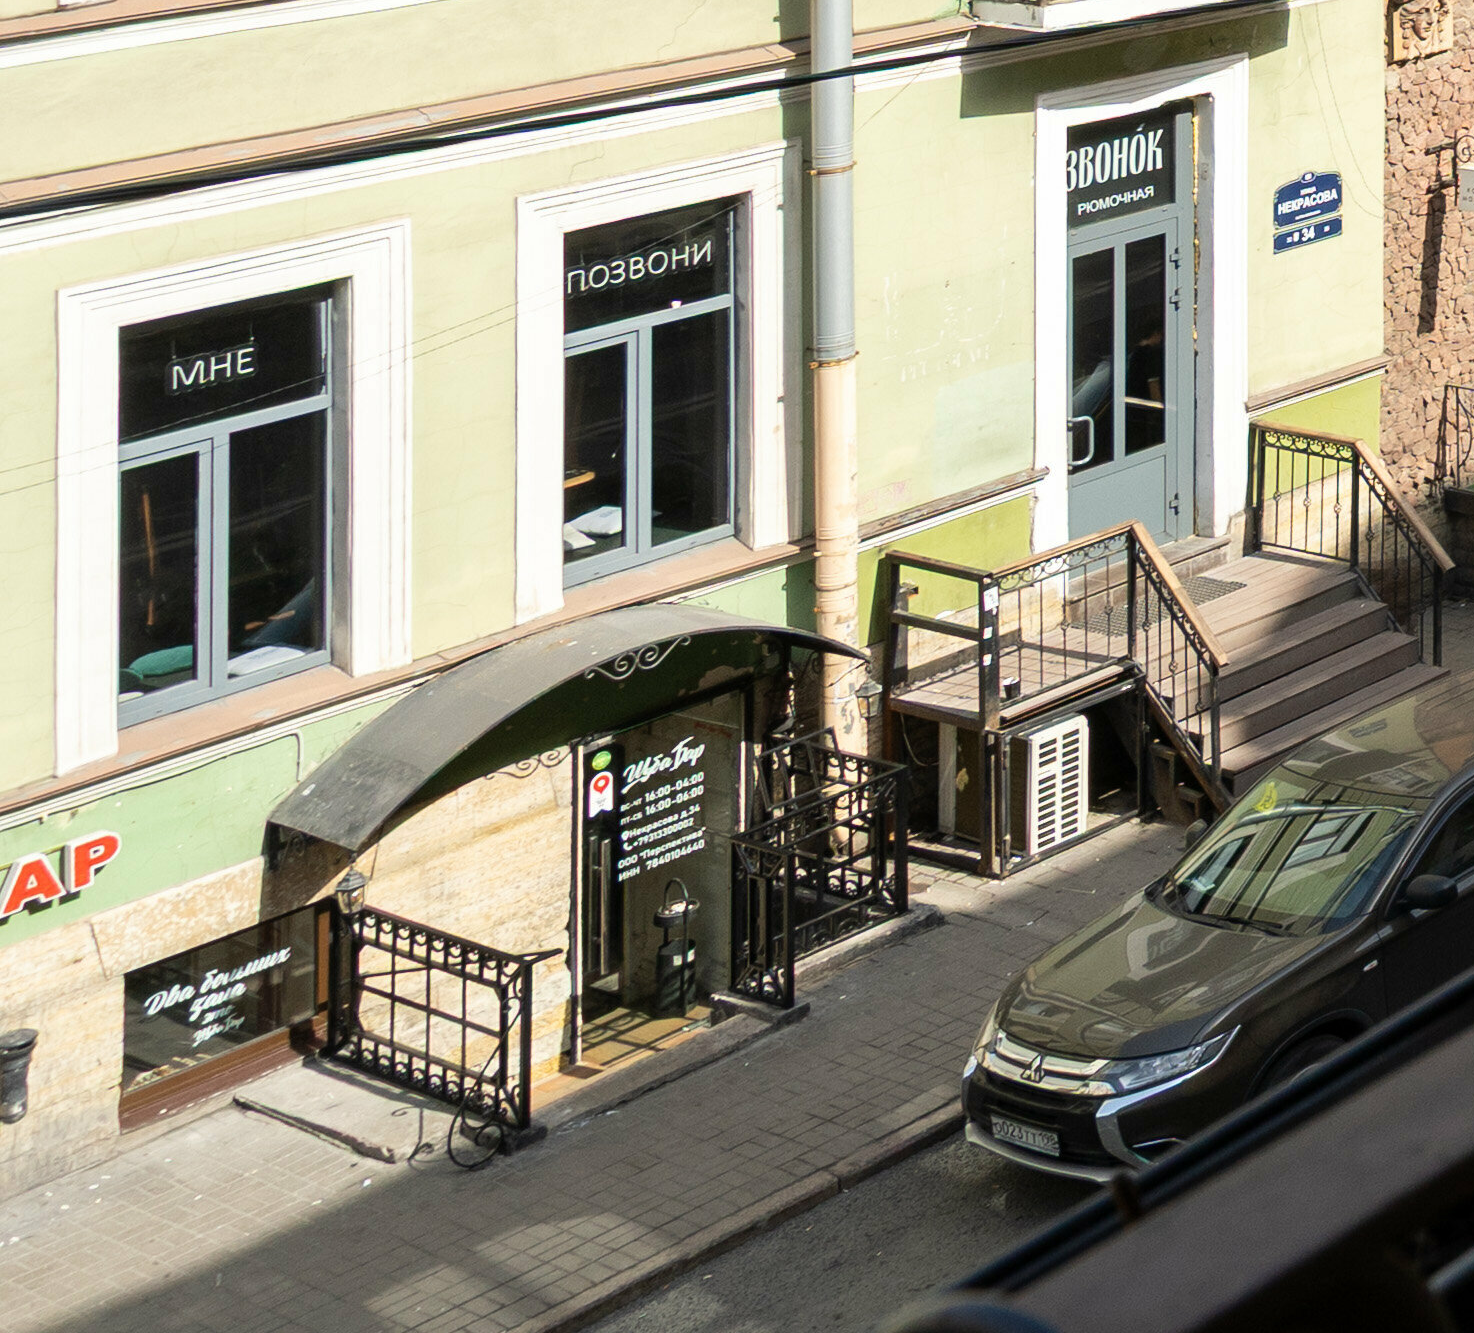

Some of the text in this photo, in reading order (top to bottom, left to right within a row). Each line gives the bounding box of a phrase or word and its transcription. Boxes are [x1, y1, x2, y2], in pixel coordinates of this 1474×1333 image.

[1078, 185, 1155, 215] РЮМОЧНАЯ
[1277, 188, 1339, 216] НЕКРАСОВА
[1301, 225, 1316, 242] 34
[567, 240, 712, 293] ПОЗВОНИ
[172, 347, 255, 390] МНЕ
[645, 785, 705, 816] 16:00-06:00
[628, 813, 679, 839] Некрасова
[617, 854, 638, 869] ООО
[618, 866, 641, 882] ИНН
[143, 983, 197, 1016] Два
